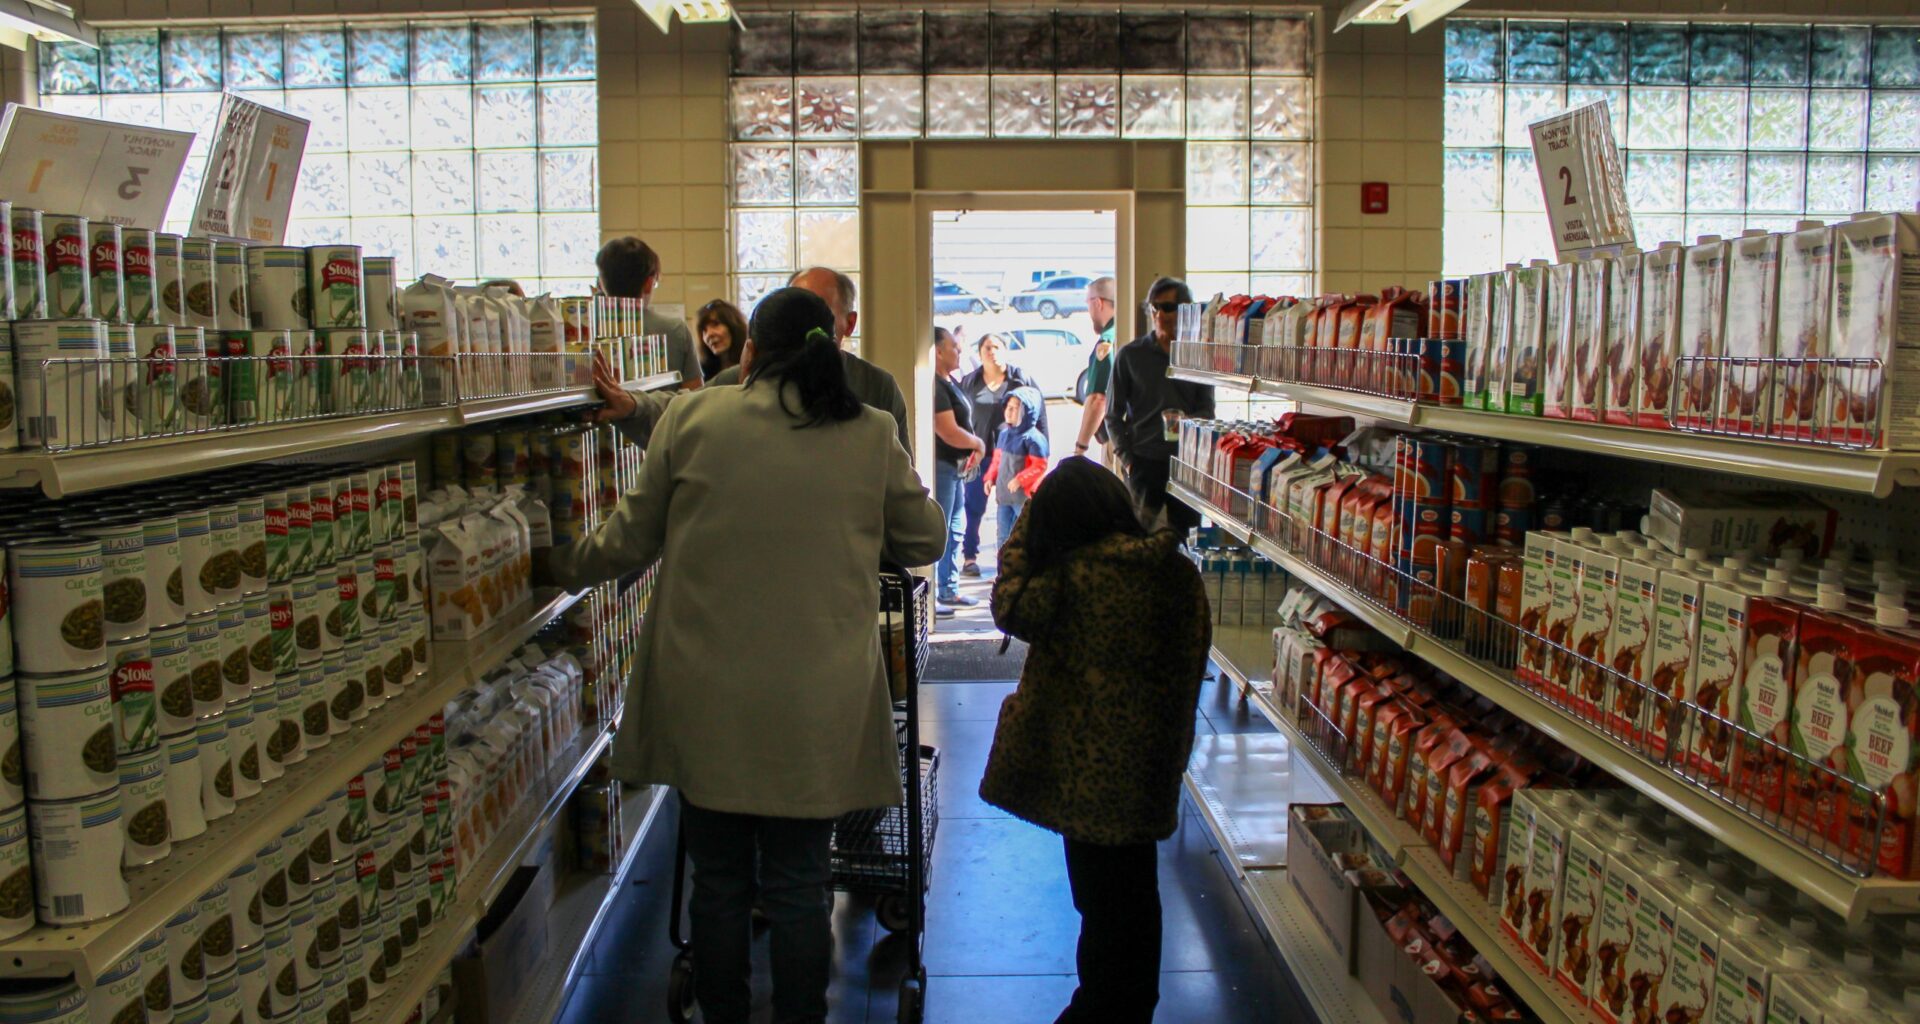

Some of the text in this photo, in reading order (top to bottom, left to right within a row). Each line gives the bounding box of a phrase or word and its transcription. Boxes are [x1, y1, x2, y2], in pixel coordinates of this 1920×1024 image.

[1548, 138, 1569, 151] TRACK
[265, 162, 278, 201] 1
[1559, 166, 1577, 206] 2
[207, 207, 227, 220] VISITA
[199, 220, 229, 234] MENSUAL
[1565, 219, 1584, 229] VISITA
[1563, 232, 1590, 242] MENSUAL
[65, 578, 83, 590] Cut
[117, 667, 152, 685] Stoke
[1811, 709, 1834, 730] BEEF
[1868, 733, 1894, 756] BEEF
